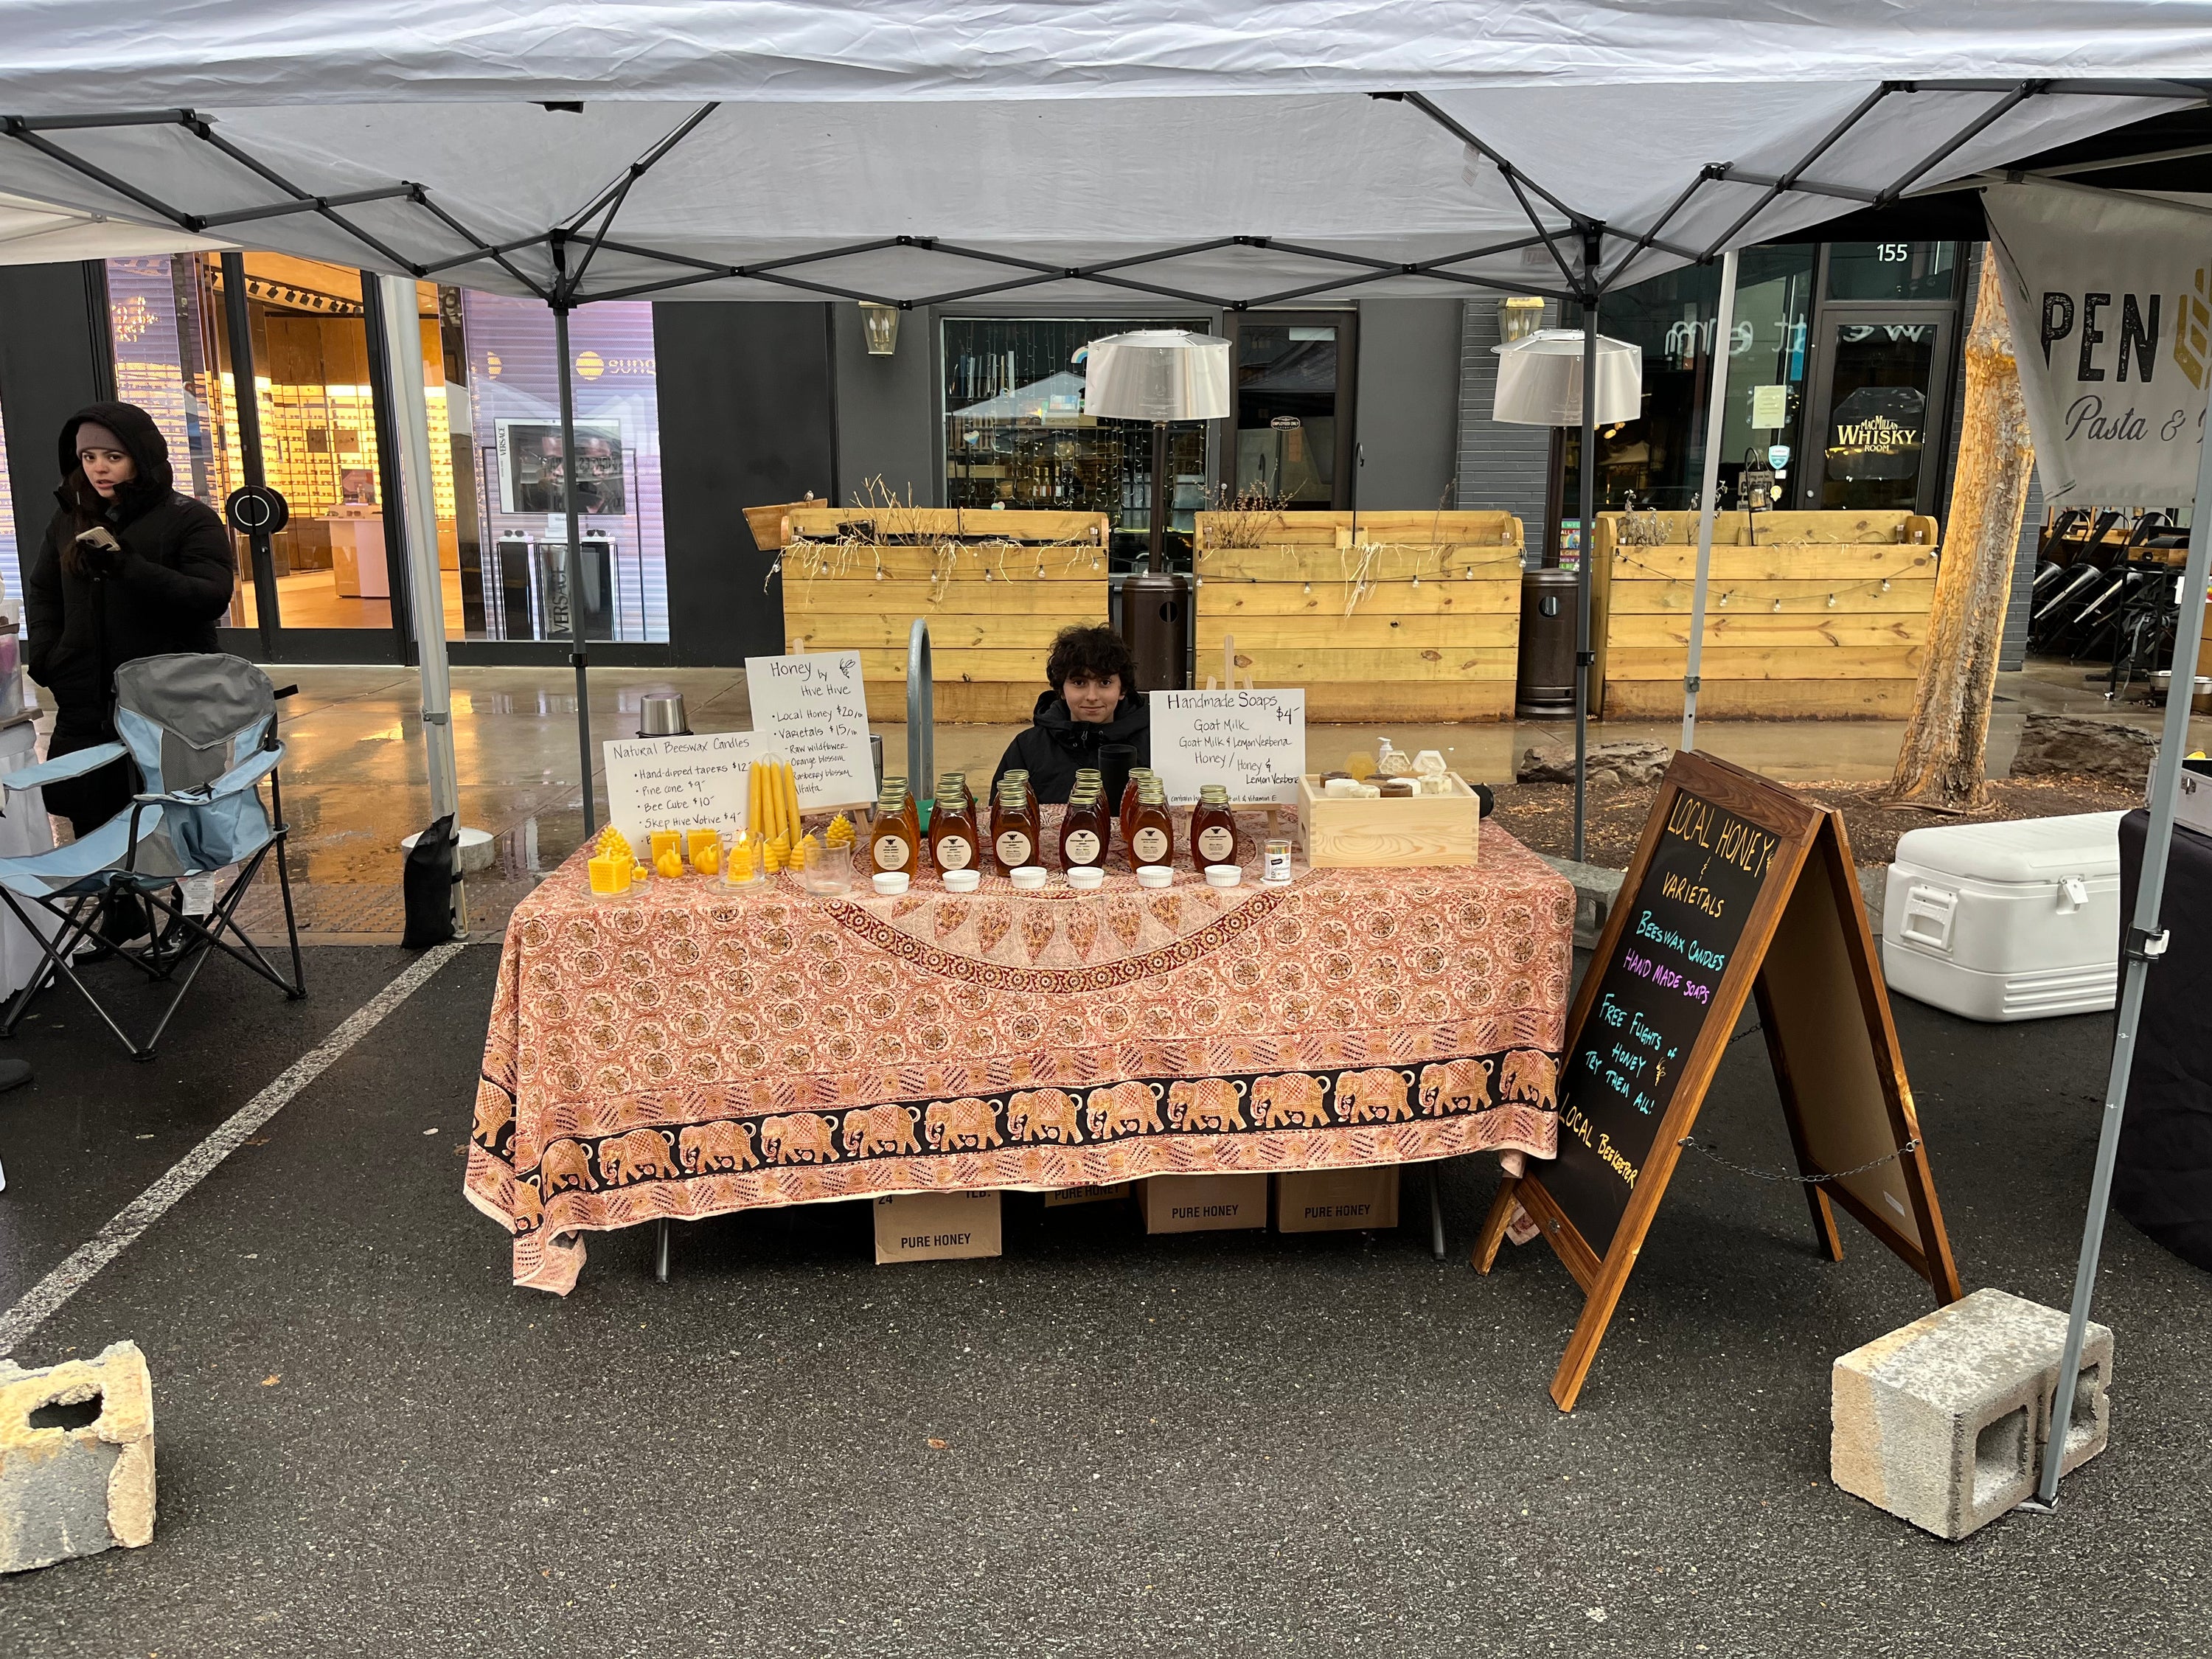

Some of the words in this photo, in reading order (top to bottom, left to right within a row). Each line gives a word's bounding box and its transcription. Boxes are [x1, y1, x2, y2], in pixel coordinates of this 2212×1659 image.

[1877, 244, 1908, 262] 155
[2065, 394, 2149, 442] Pasta
[2160, 410, 2186, 442] &
[498, 426, 507, 456] VERSACE
[1837, 425, 1917, 445] WHISKY
[771, 662, 811, 681] Honey
[818, 669, 827, 681] by
[801, 685, 823, 697] Hive
[827, 684, 851, 695] Hive
[1168, 694, 1234, 709] Handmade
[1239, 692, 1278, 710] Soaps
[776, 709, 803, 723] Local
[807, 709, 832, 725] Honey
[1194, 719, 1220, 733] Goat
[1224, 719, 1250, 731] Milk
[613, 742, 658, 759] Natural
[664, 741, 709, 754] Beeswax
[713, 737, 750, 750] Candles
[790, 745, 805, 754] Raw
[1179, 736, 1203, 748] Goat
[1204, 737, 1224, 747] Milk
[790, 757, 816, 770] Orange
[818, 754, 846, 763] blossom
[1195, 751, 1226, 768] Honey
[1237, 759, 1262, 776] Honey
[639, 765, 692, 779] Hand-dipped
[695, 765, 728, 774] tapers
[1246, 774, 1270, 785] Lemon
[642, 785, 661, 796] Pine
[664, 783, 684, 793] cone
[644, 802, 663, 813] Bee
[667, 799, 689, 810] Cube
[644, 818, 669, 830] Skep
[672, 816, 690, 827] Hive
[693, 813, 721, 824] Votive
[1667, 793, 1715, 849] LOCAL
[1715, 818, 1775, 878] HONEY
[1662, 872, 1725, 918] VARIETALS
[1636, 910, 1686, 954] BEESWAX
[1623, 947, 1652, 978] HAND
[1652, 964, 1683, 988] MADE
[1683, 981, 1710, 1004] SOAPS
[1599, 993, 1627, 1027] FREE
[1611, 1042, 1646, 1078] HONEY
[1585, 1051, 1603, 1075] TRY
[1605, 1070, 1630, 1098] THEM
[1558, 1093, 1593, 1148] LOCAL
[1054, 1186, 1082, 1200] PURE
[1085, 1183, 1120, 1198] HONEY
[1172, 1206, 1200, 1219] PURE
[1203, 1204, 1239, 1217] HONEY
[1304, 1206, 1332, 1218] PURE
[1335, 1204, 1371, 1217] HONEY
[901, 1236, 931, 1248] PURE
[934, 1233, 971, 1246] HONEY
